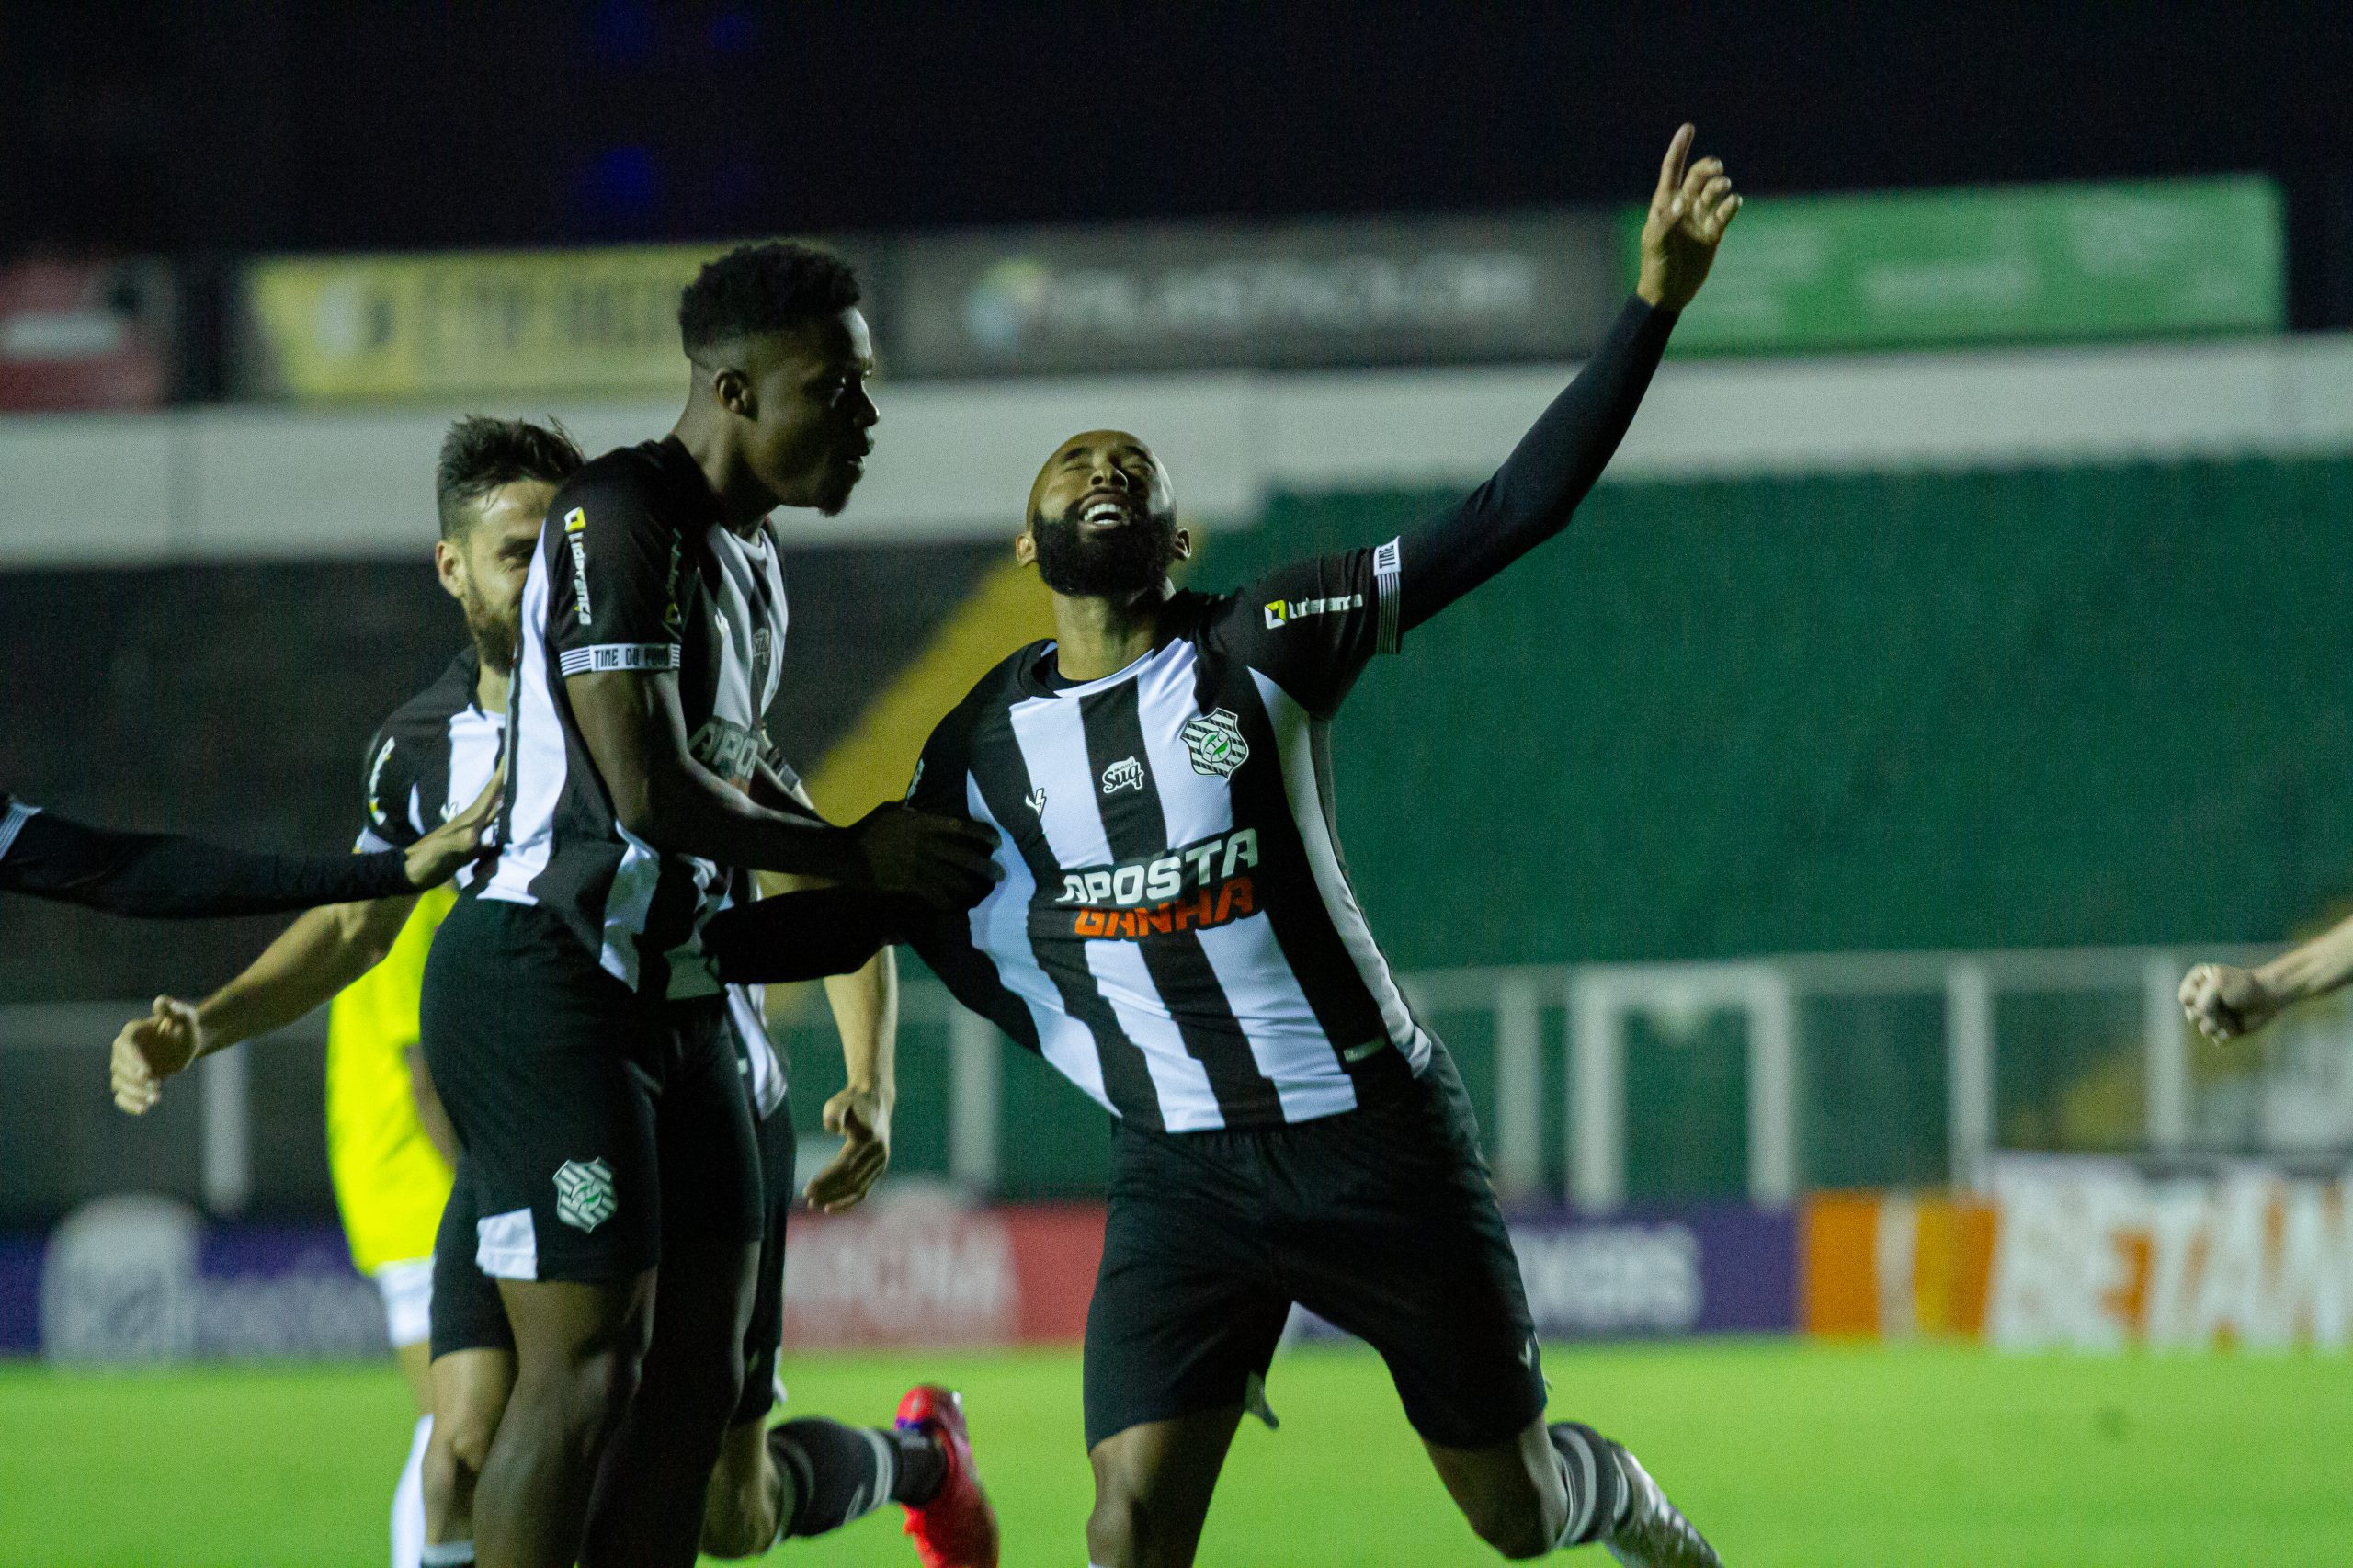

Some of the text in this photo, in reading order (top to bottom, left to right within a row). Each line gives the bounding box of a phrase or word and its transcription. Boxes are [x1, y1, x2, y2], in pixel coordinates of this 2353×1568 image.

[594, 647, 619, 669] TIME
[1054, 827, 1259, 905] APOSTA
[1074, 876, 1254, 937] GANHA
